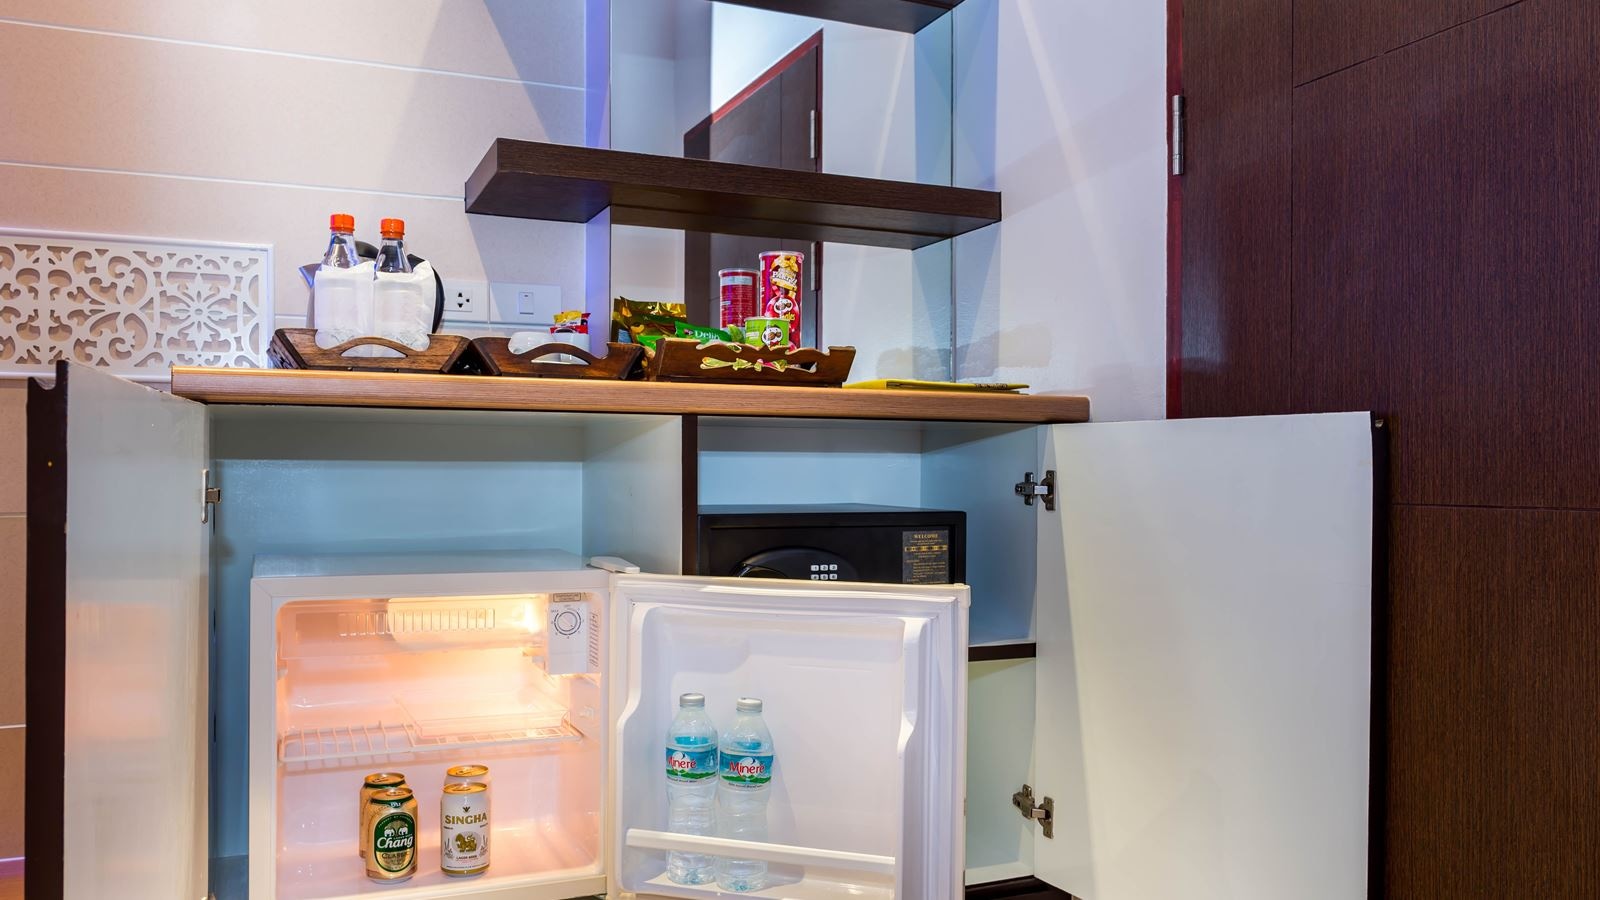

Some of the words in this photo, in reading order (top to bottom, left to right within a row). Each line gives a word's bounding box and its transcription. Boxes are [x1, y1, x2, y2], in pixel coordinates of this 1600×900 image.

[729, 760, 766, 776] Mineré
[444, 812, 488, 825] SINGHA
[376, 835, 414, 849] Chang
